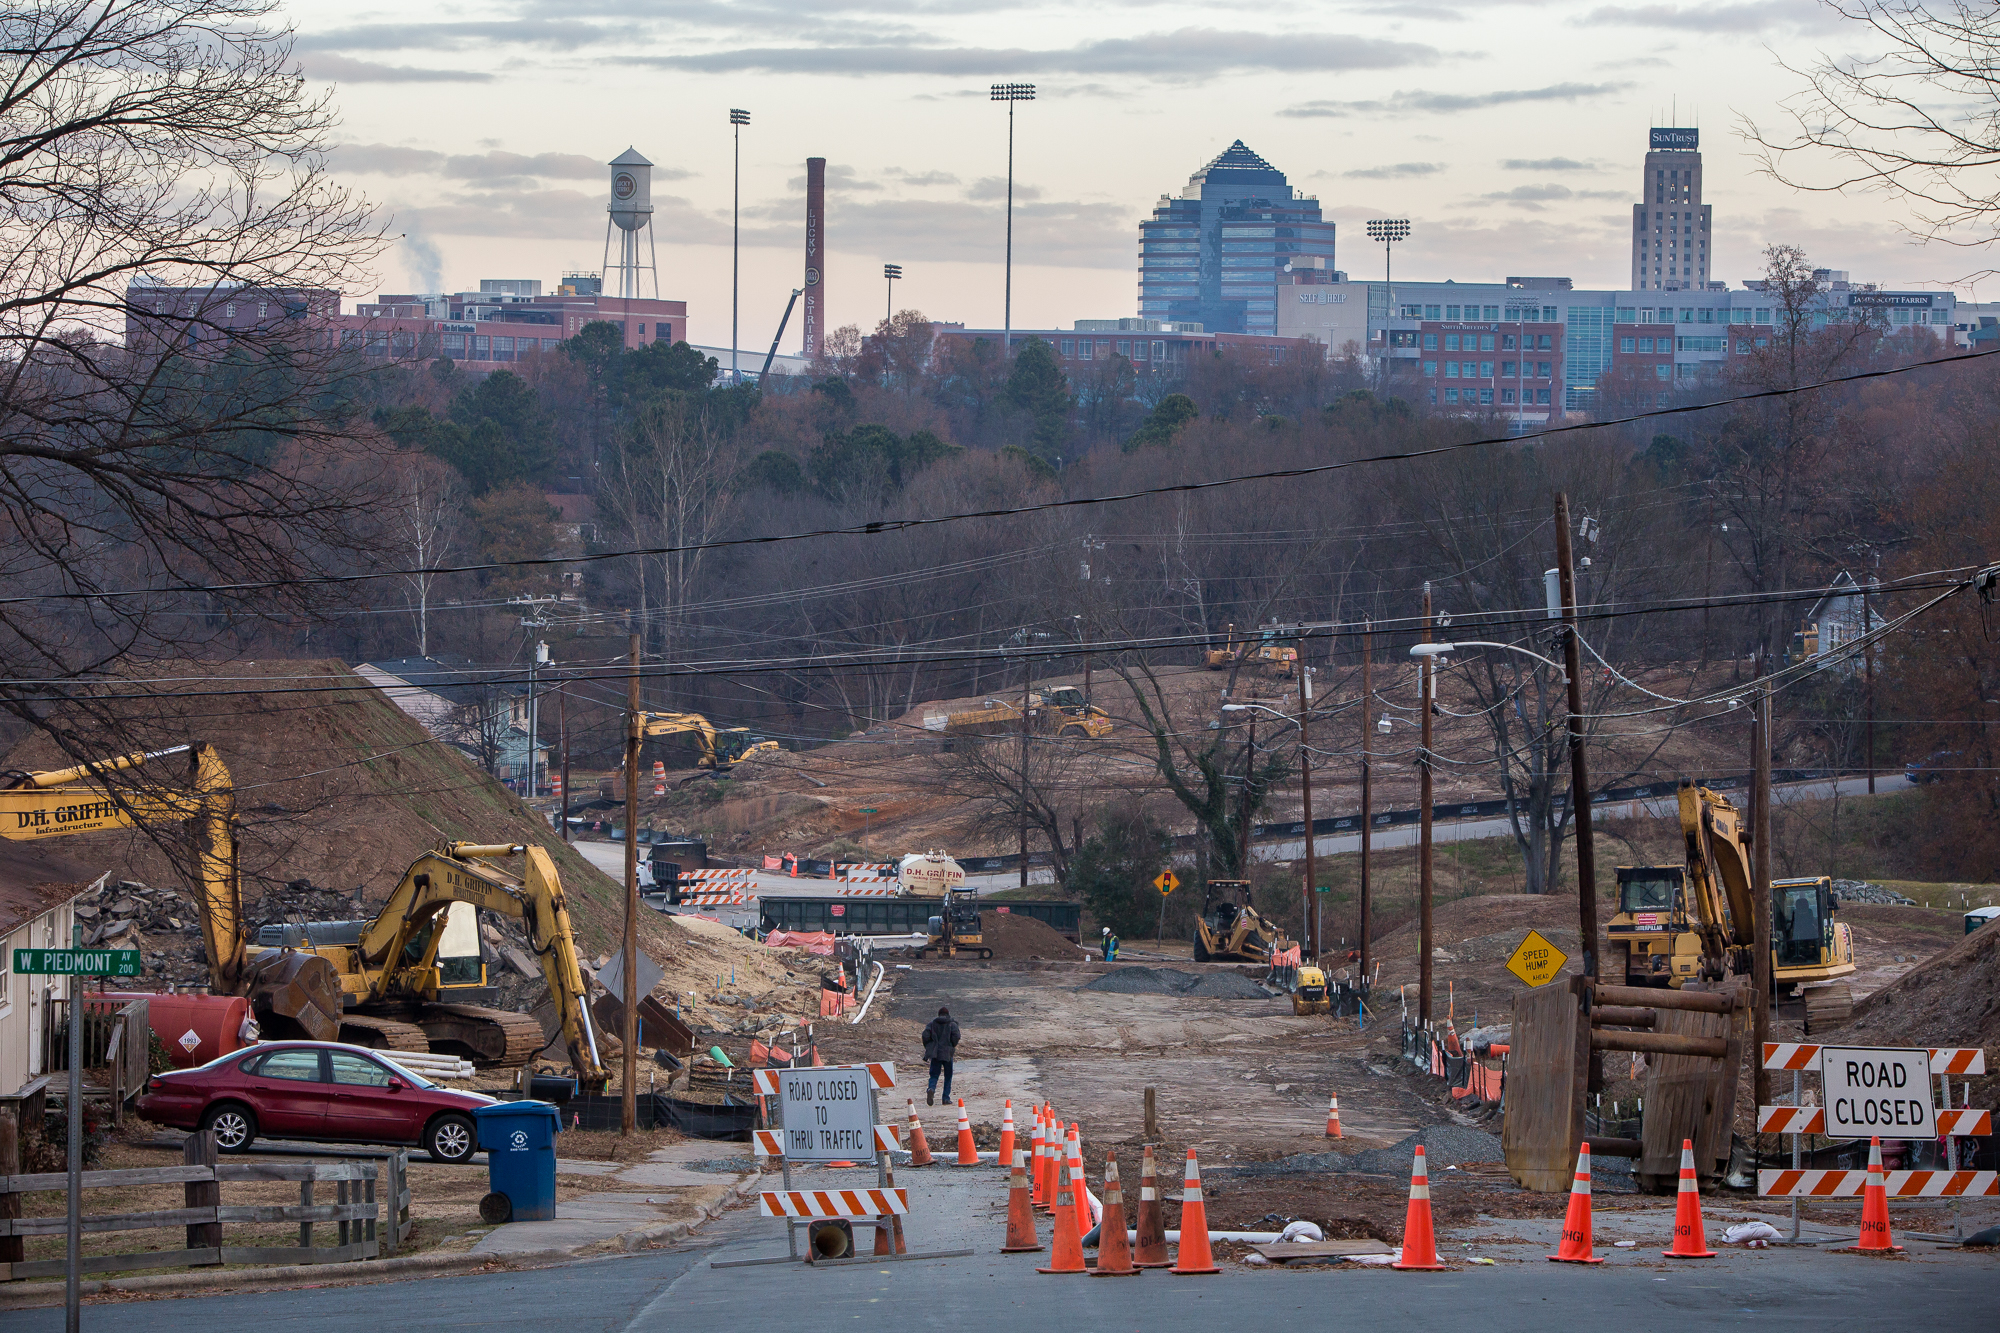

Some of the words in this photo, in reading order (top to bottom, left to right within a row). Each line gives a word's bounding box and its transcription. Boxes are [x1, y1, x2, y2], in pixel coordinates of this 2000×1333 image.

[808, 209, 816, 257] LUCKY
[1299, 293, 1317, 303] SELF
[1327, 293, 1347, 303] HELP
[806, 296, 815, 353] STRIKE
[17, 809, 50, 828] D.H.
[35, 821, 104, 835] Infrastructure
[905, 868, 924, 876] D.H.
[927, 869, 963, 879] GRIFFIN
[447, 871, 463, 887] D.H.
[465, 876, 493, 896] GRIFFIN
[21, 952, 35, 971] W.
[43, 952, 112, 972] PIEDMONT
[121, 951, 132, 961] AV
[1522, 948, 1549, 961] SPEED
[118, 963, 134, 974] 200
[1525, 959, 1549, 972] HUMP
[1532, 973, 1550, 981] AHEAD
[1846, 1060, 1907, 1088] ROAD
[788, 1081, 813, 1101] ROAD
[817, 1080, 858, 1101] CLOSED
[815, 1105, 828, 1126] TO
[1835, 1097, 1924, 1126] CLOSED
[790, 1130, 813, 1150] THRU
[819, 1129, 863, 1150] TRAFFIC
[1674, 1224, 1691, 1236] HGI
[1862, 1220, 1886, 1233] DHGI
[1560, 1228, 1584, 1243] DHGI
